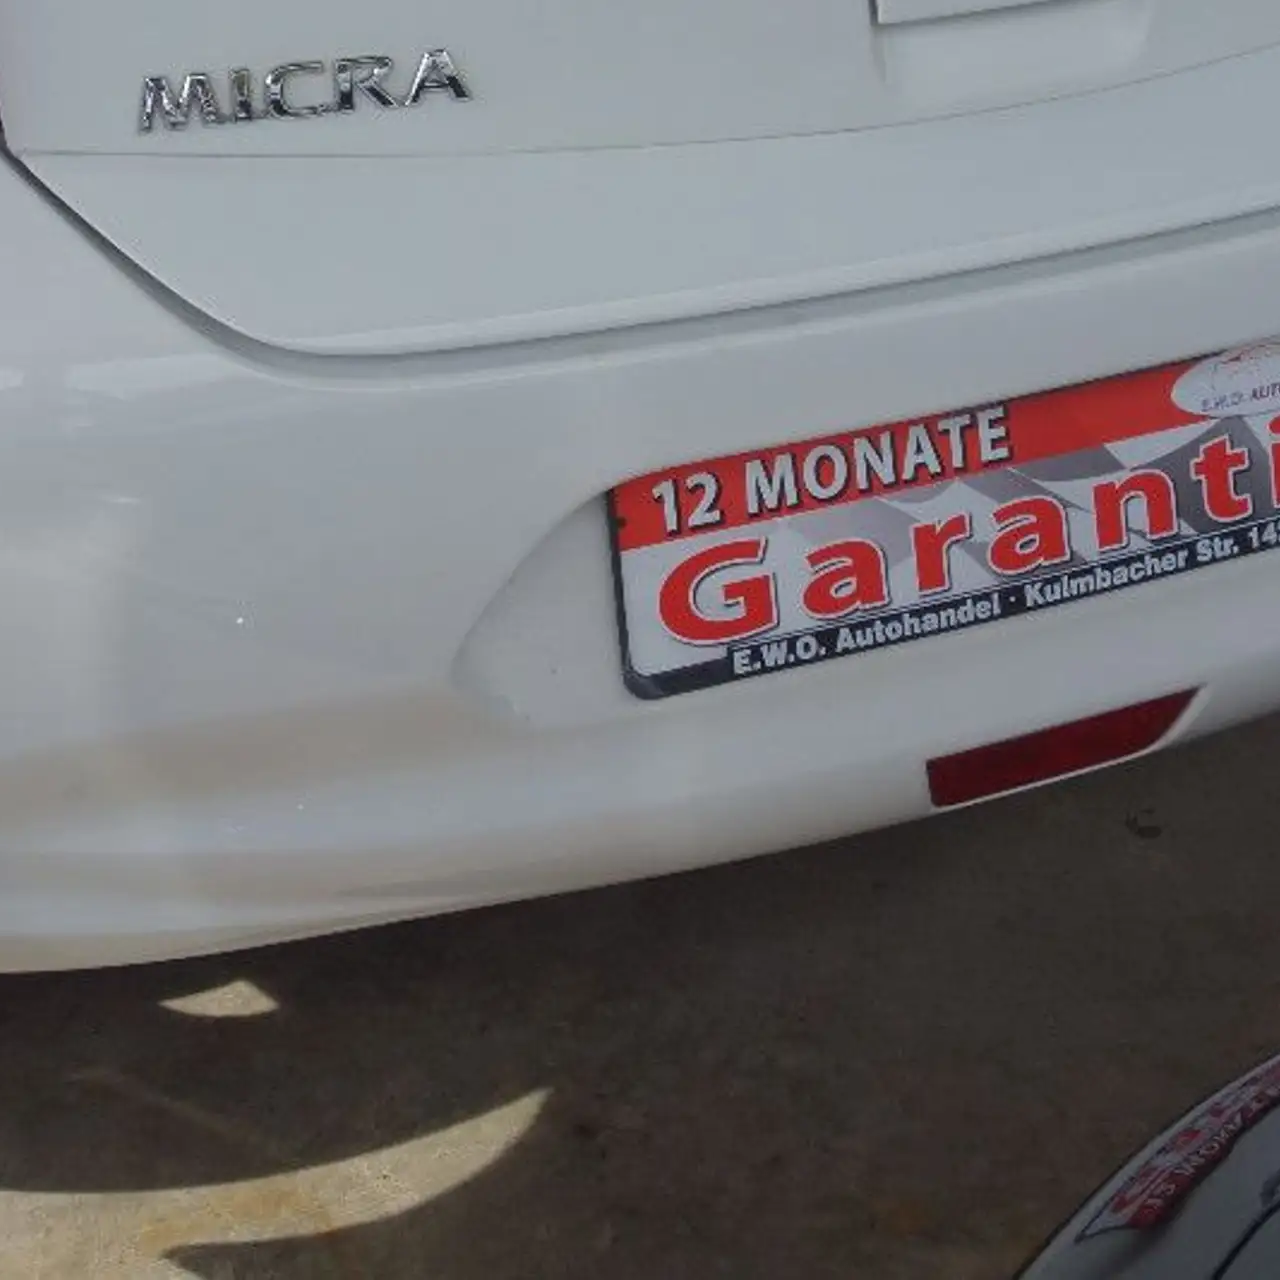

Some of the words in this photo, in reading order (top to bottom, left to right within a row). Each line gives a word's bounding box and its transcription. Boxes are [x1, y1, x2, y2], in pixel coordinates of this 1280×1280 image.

[137, 48, 473, 135] MICRA
[652, 471, 722, 532] 12
[744, 406, 1011, 517] MONATE
[733, 636, 827, 675] E.W.O.
[836, 592, 1002, 653] Autohandel
[1023, 547, 1190, 609] Kulmbacher
[1196, 535, 1240, 563] Str.
